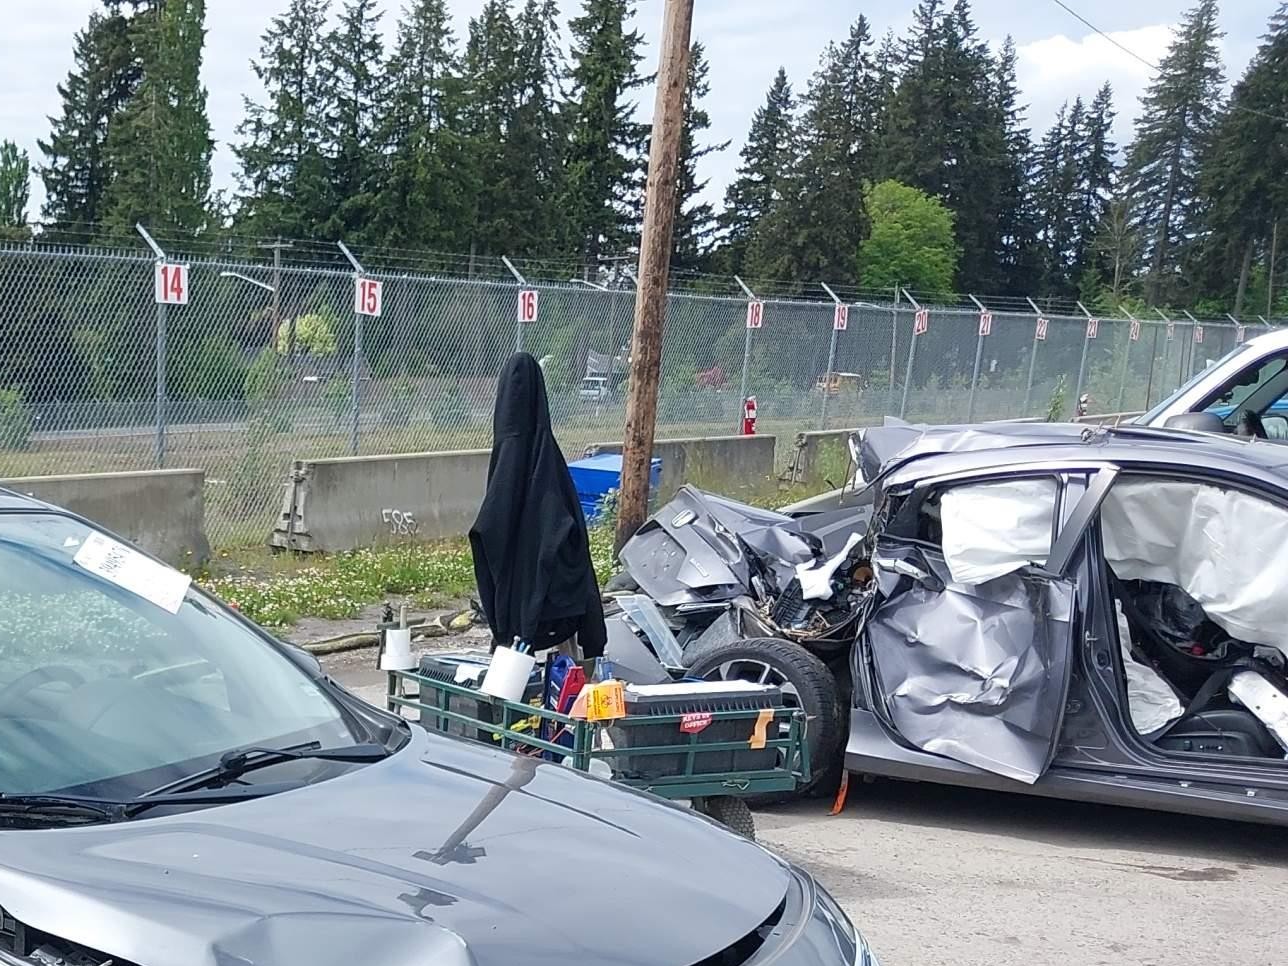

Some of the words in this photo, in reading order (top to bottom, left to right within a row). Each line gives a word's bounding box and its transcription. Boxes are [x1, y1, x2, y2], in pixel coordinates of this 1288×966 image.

[161, 265, 184, 302] 14
[360, 280, 377, 314] 15
[521, 292, 535, 321] 16
[749, 302, 761, 327] 18
[836, 305, 847, 329] 19
[915, 311, 927, 333] 20
[980, 314, 991, 334] 21
[1037, 319, 1047, 338] 22
[381, 508, 418, 535] 585
